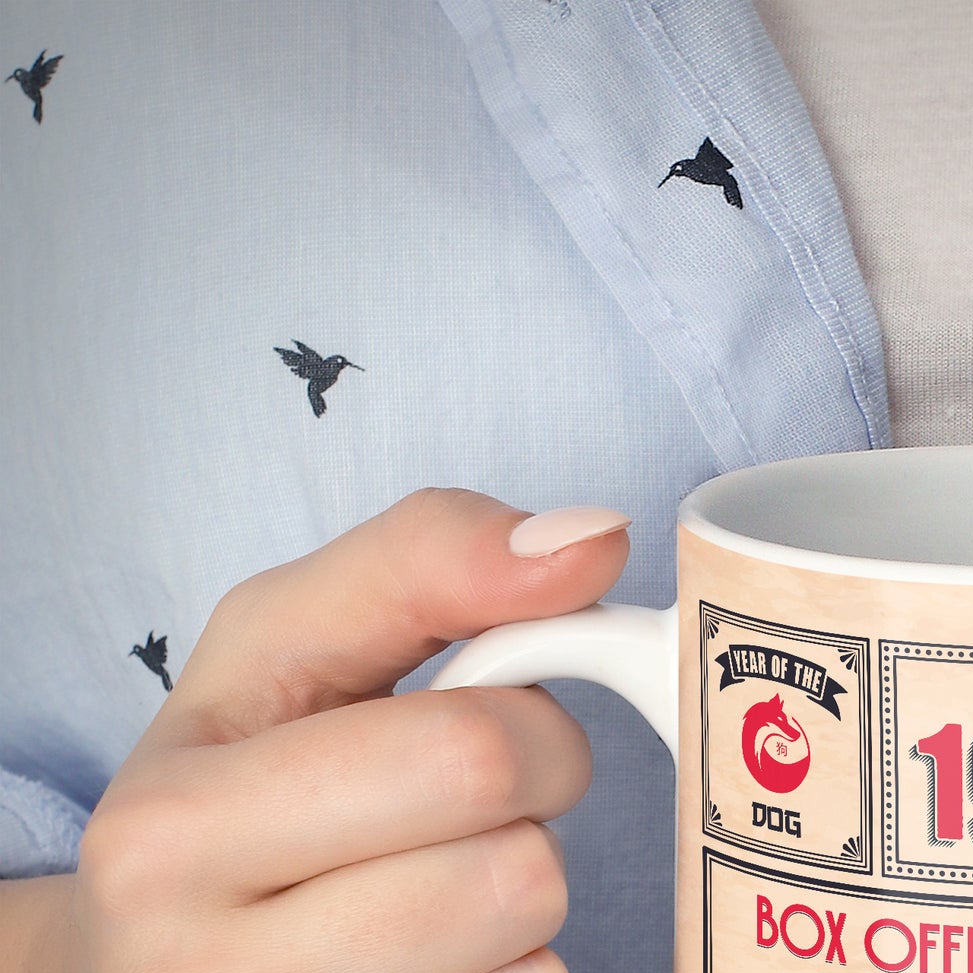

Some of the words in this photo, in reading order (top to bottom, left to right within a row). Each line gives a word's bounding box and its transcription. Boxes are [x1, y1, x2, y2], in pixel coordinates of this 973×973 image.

[733, 650, 767, 675] YEAR
[771, 654, 788, 680] OF
[794, 661, 822, 693] THE
[752, 801, 802, 838] DOG
[756, 894, 847, 966] BOX
